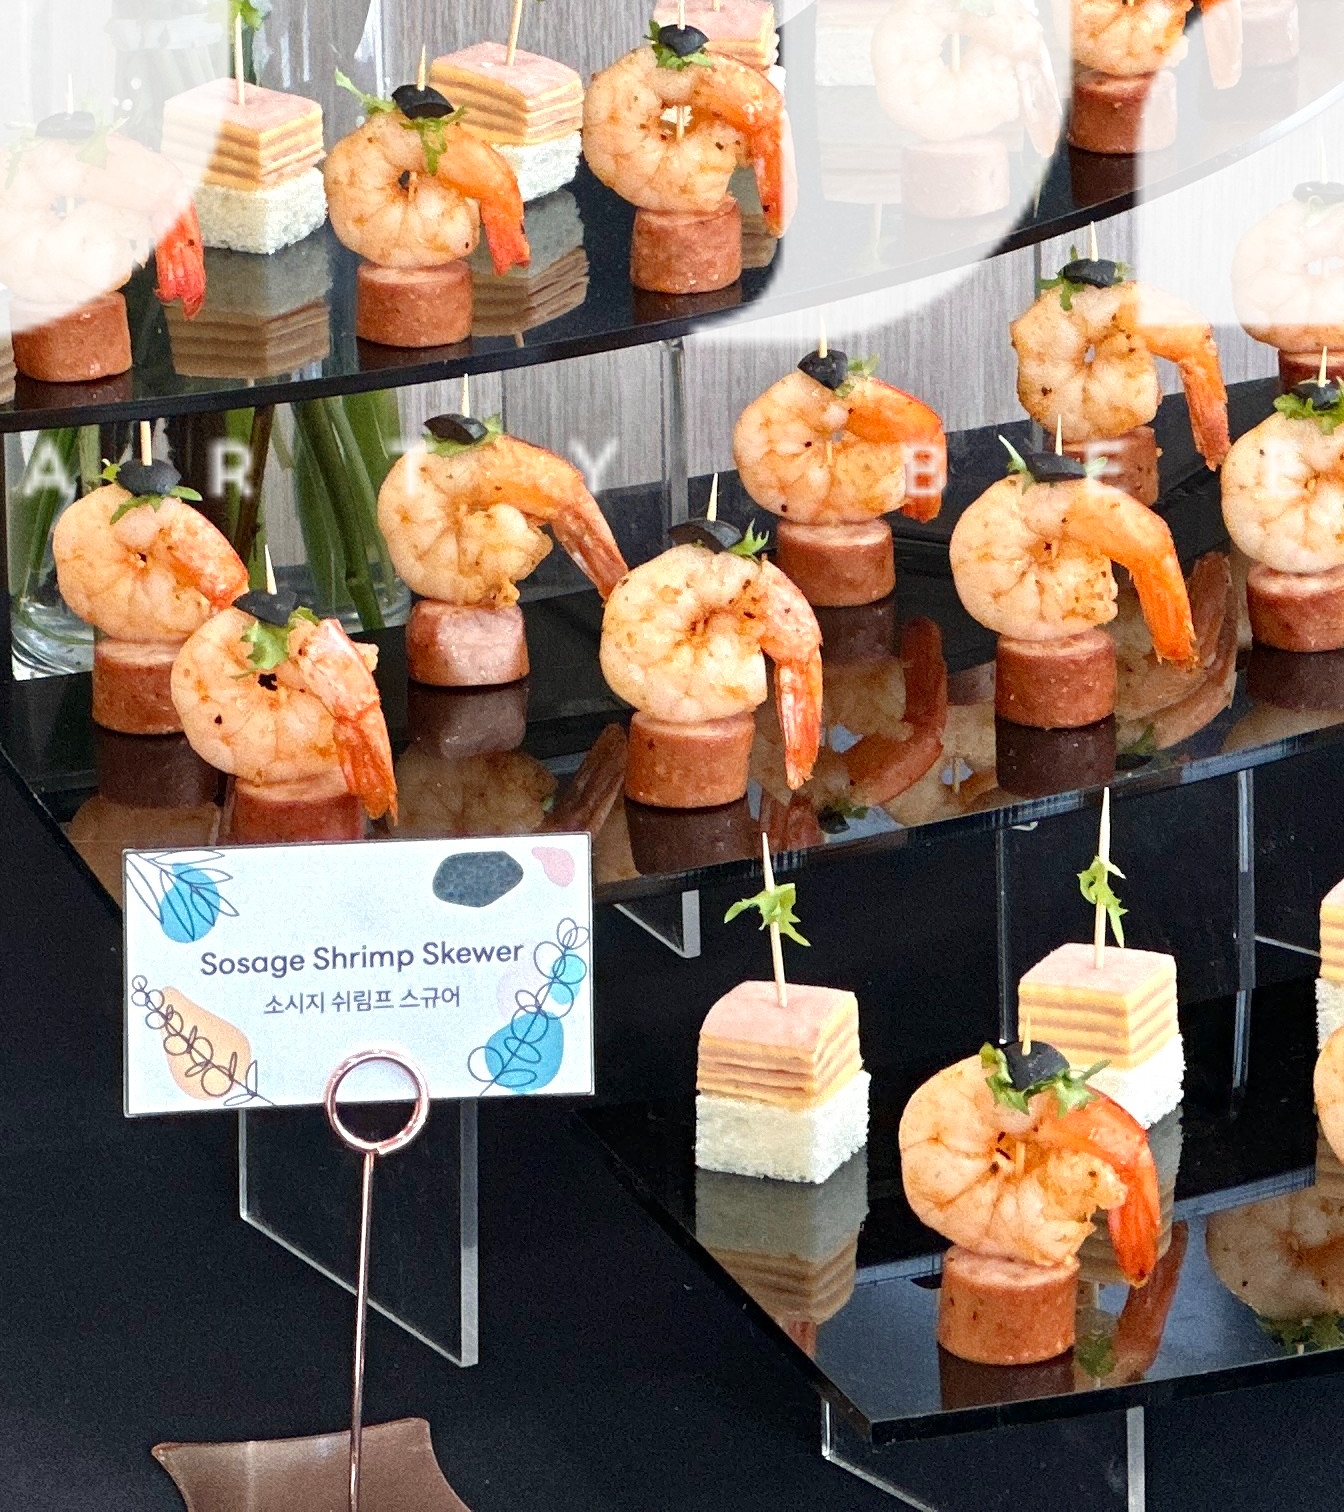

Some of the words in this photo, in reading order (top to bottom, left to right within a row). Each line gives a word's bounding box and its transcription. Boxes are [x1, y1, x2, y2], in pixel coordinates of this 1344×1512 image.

[199, 951, 306, 979] Sosage
[312, 944, 415, 973] Shrimp
[421, 941, 524, 966] Skewer
[263, 992, 326, 1016] 소시지
[330, 988, 395, 1012] 쉬림프
[398, 985, 461, 1009] 스규어
